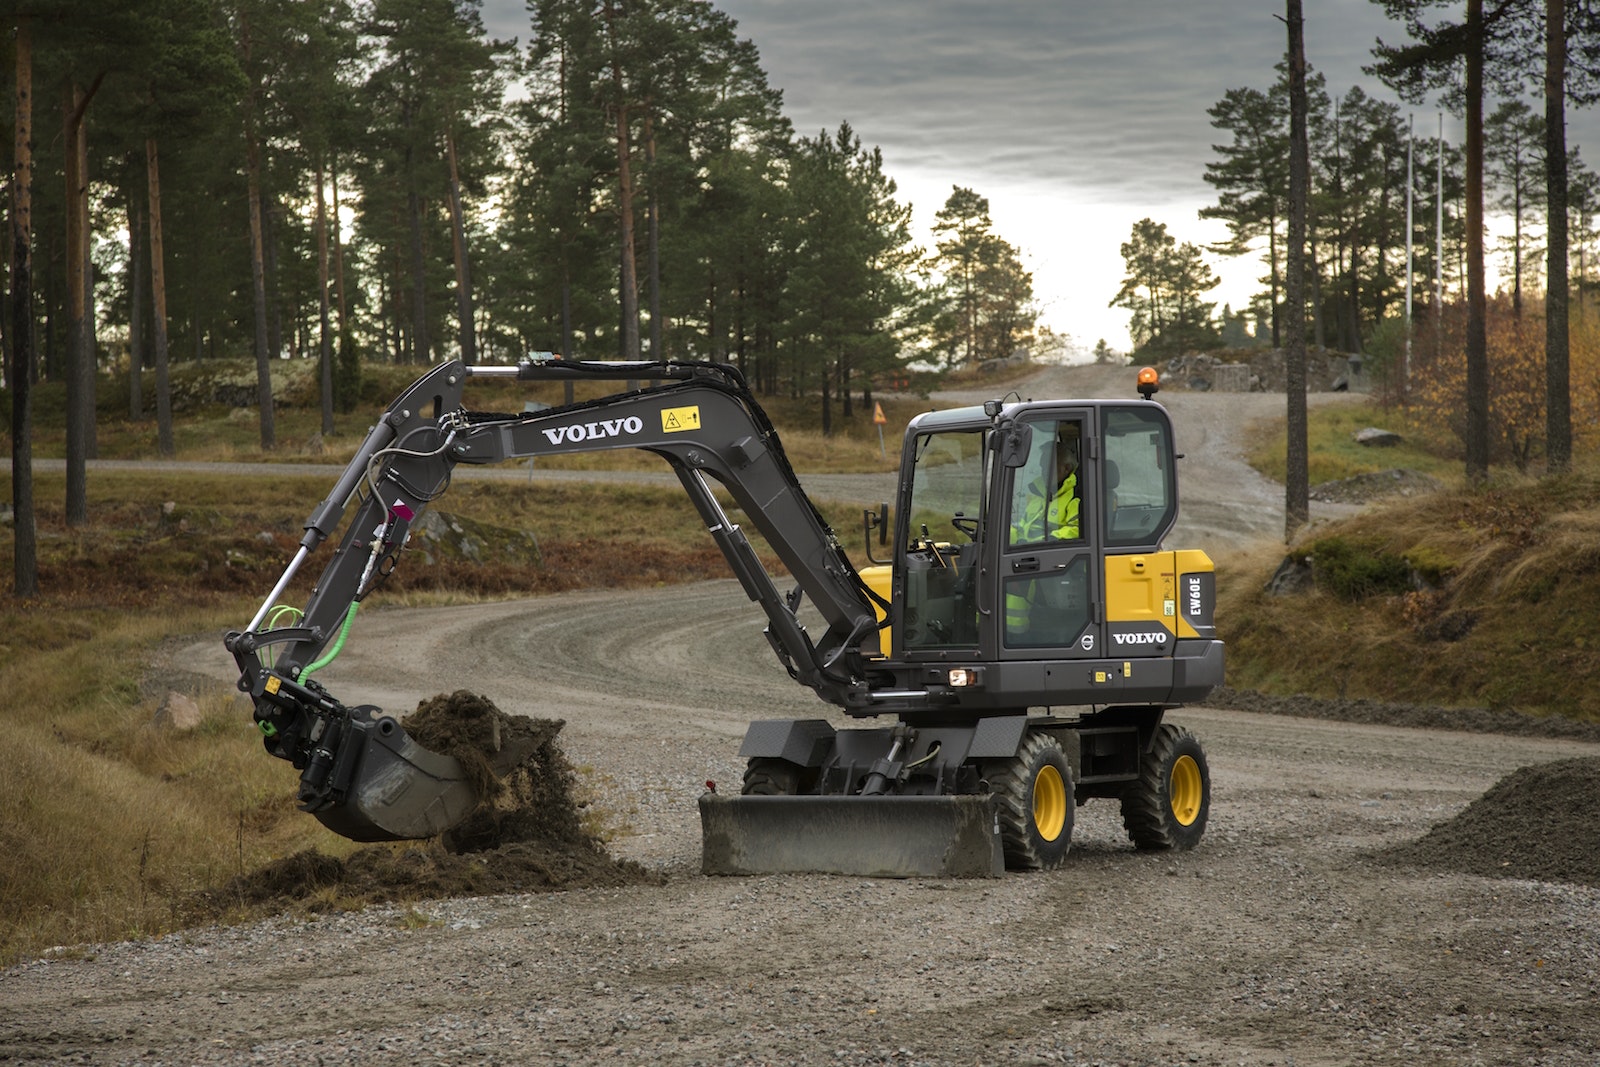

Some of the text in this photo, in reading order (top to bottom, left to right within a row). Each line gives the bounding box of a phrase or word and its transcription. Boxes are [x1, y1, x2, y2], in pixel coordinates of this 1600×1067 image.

[542, 416, 643, 445] VOLVO
[1189, 577, 1201, 616] EW60E
[1113, 632, 1167, 645] VOLVO
